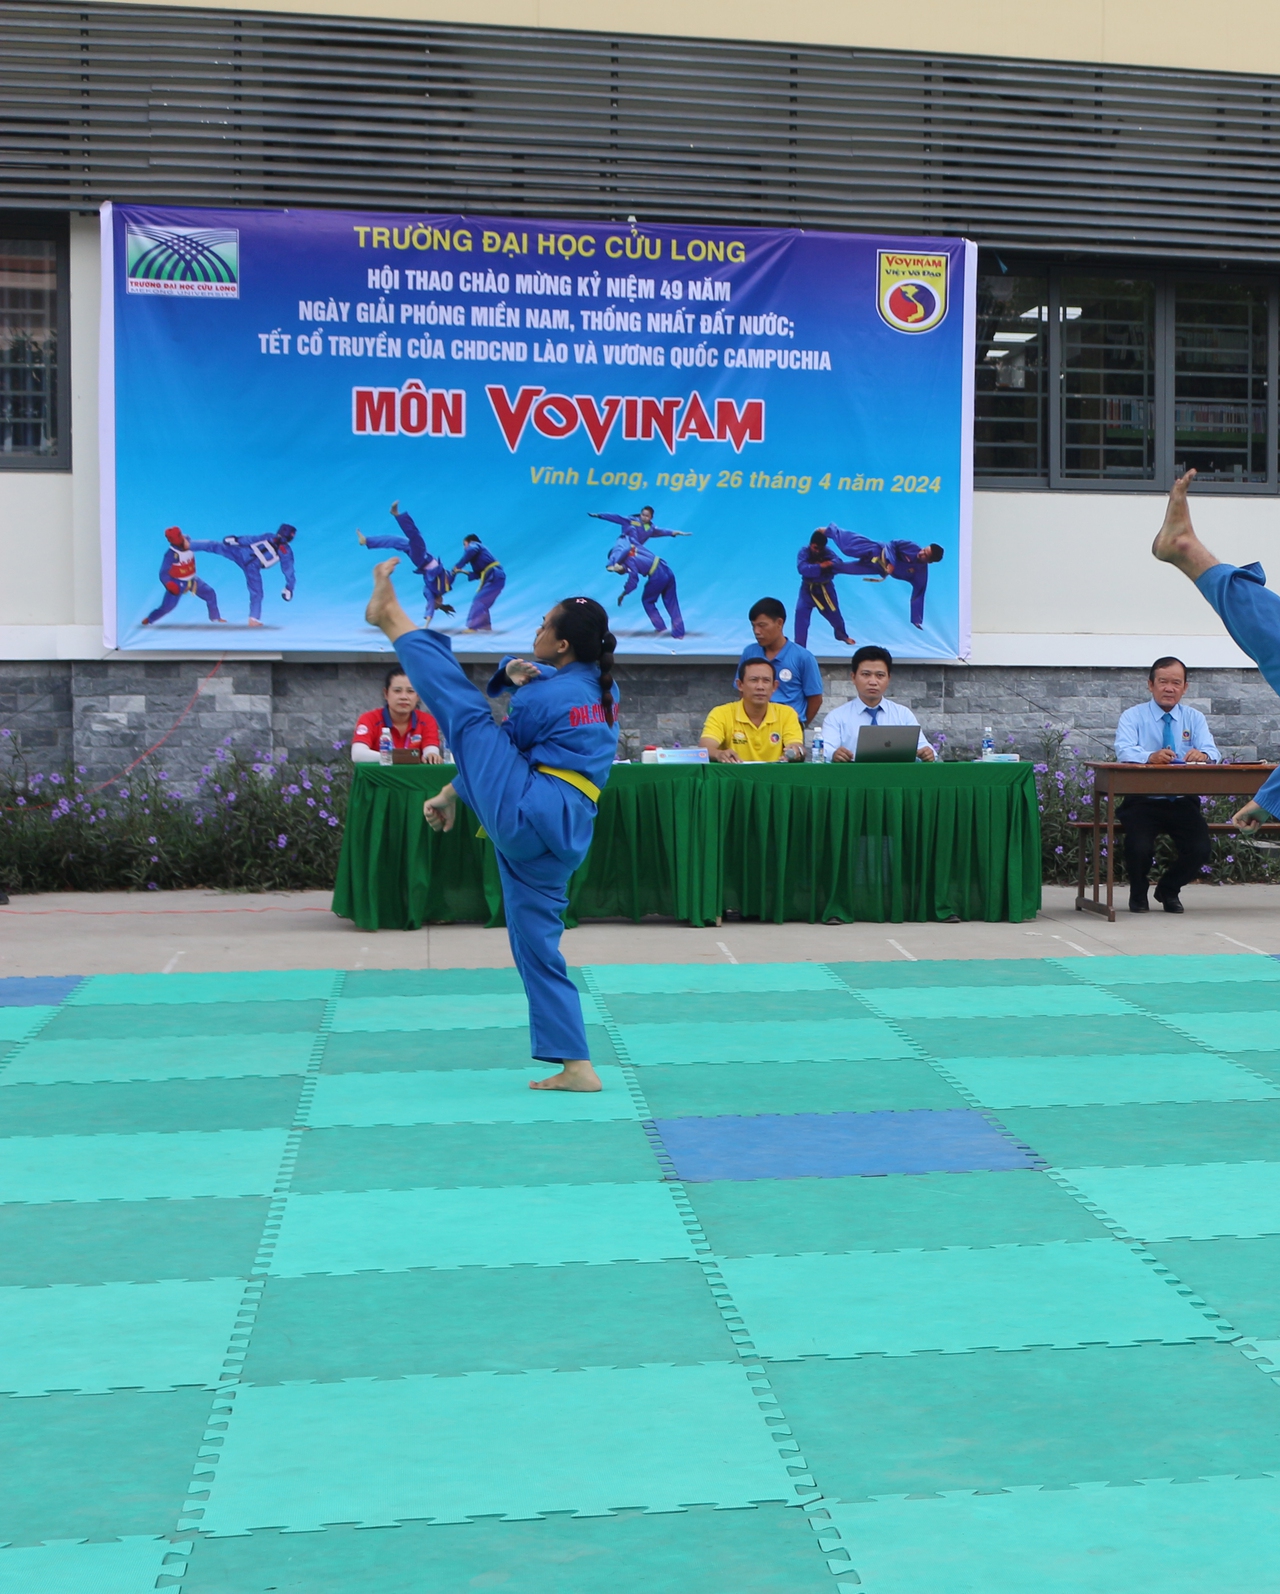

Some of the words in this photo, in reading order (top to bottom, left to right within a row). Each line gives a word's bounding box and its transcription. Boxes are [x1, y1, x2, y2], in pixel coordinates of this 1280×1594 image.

[354, 223, 473, 253] TRƯỜNG
[482, 230, 528, 256] ĐẠI
[538, 234, 596, 261] HỌC
[605, 228, 662, 261] CỬU
[671, 239, 746, 263] LONG
[885, 256, 942, 268] VOVINAM
[130, 280, 161, 288] TRƯỜNG
[215, 284, 236, 292] LONG
[367, 265, 400, 295] HỘI
[405, 270, 454, 292] THAO
[459, 267, 510, 294] CHÀO
[515, 270, 572, 297] MỪNG
[577, 270, 602, 297] KỶ
[606, 274, 655, 302] NIỆM
[660, 279, 683, 300] 49
[687, 276, 731, 302] NĂM
[298, 297, 351, 324] NGÀY
[356, 297, 395, 325] GIẢI
[400, 300, 465, 326] PHÓNG
[471, 300, 520, 328] MIỀN
[525, 309, 575, 333] NAM,
[580, 304, 642, 332] THỐNG
[647, 307, 696, 335] NHẤT
[700, 308, 735, 336] ĐẤT
[739, 311, 795, 340] NƯỚC;
[258, 328, 292, 355] TẾT
[297, 328, 324, 356] CỔ
[328, 331, 402, 358] TRUYỀN
[407, 332, 446, 360] CỦA
[451, 339, 528, 362] CHDCND
[533, 338, 569, 363] LÀO
[573, 339, 598, 365] VÀ
[602, 343, 665, 367] VƯƠNG
[670, 340, 719, 369] QUỐC
[723, 348, 832, 371] CAMPUCHIA
[353, 380, 465, 436] MÔN
[485, 385, 765, 454] VOVINAM
[529, 466, 580, 486] Vĩnh
[586, 467, 648, 491] Long,
[656, 468, 709, 492] ngày
[716, 470, 742, 490] 26
[749, 469, 811, 495] tháng
[818, 473, 831, 490] 4
[837, 473, 885, 492] năm
[890, 476, 941, 494] 2024
